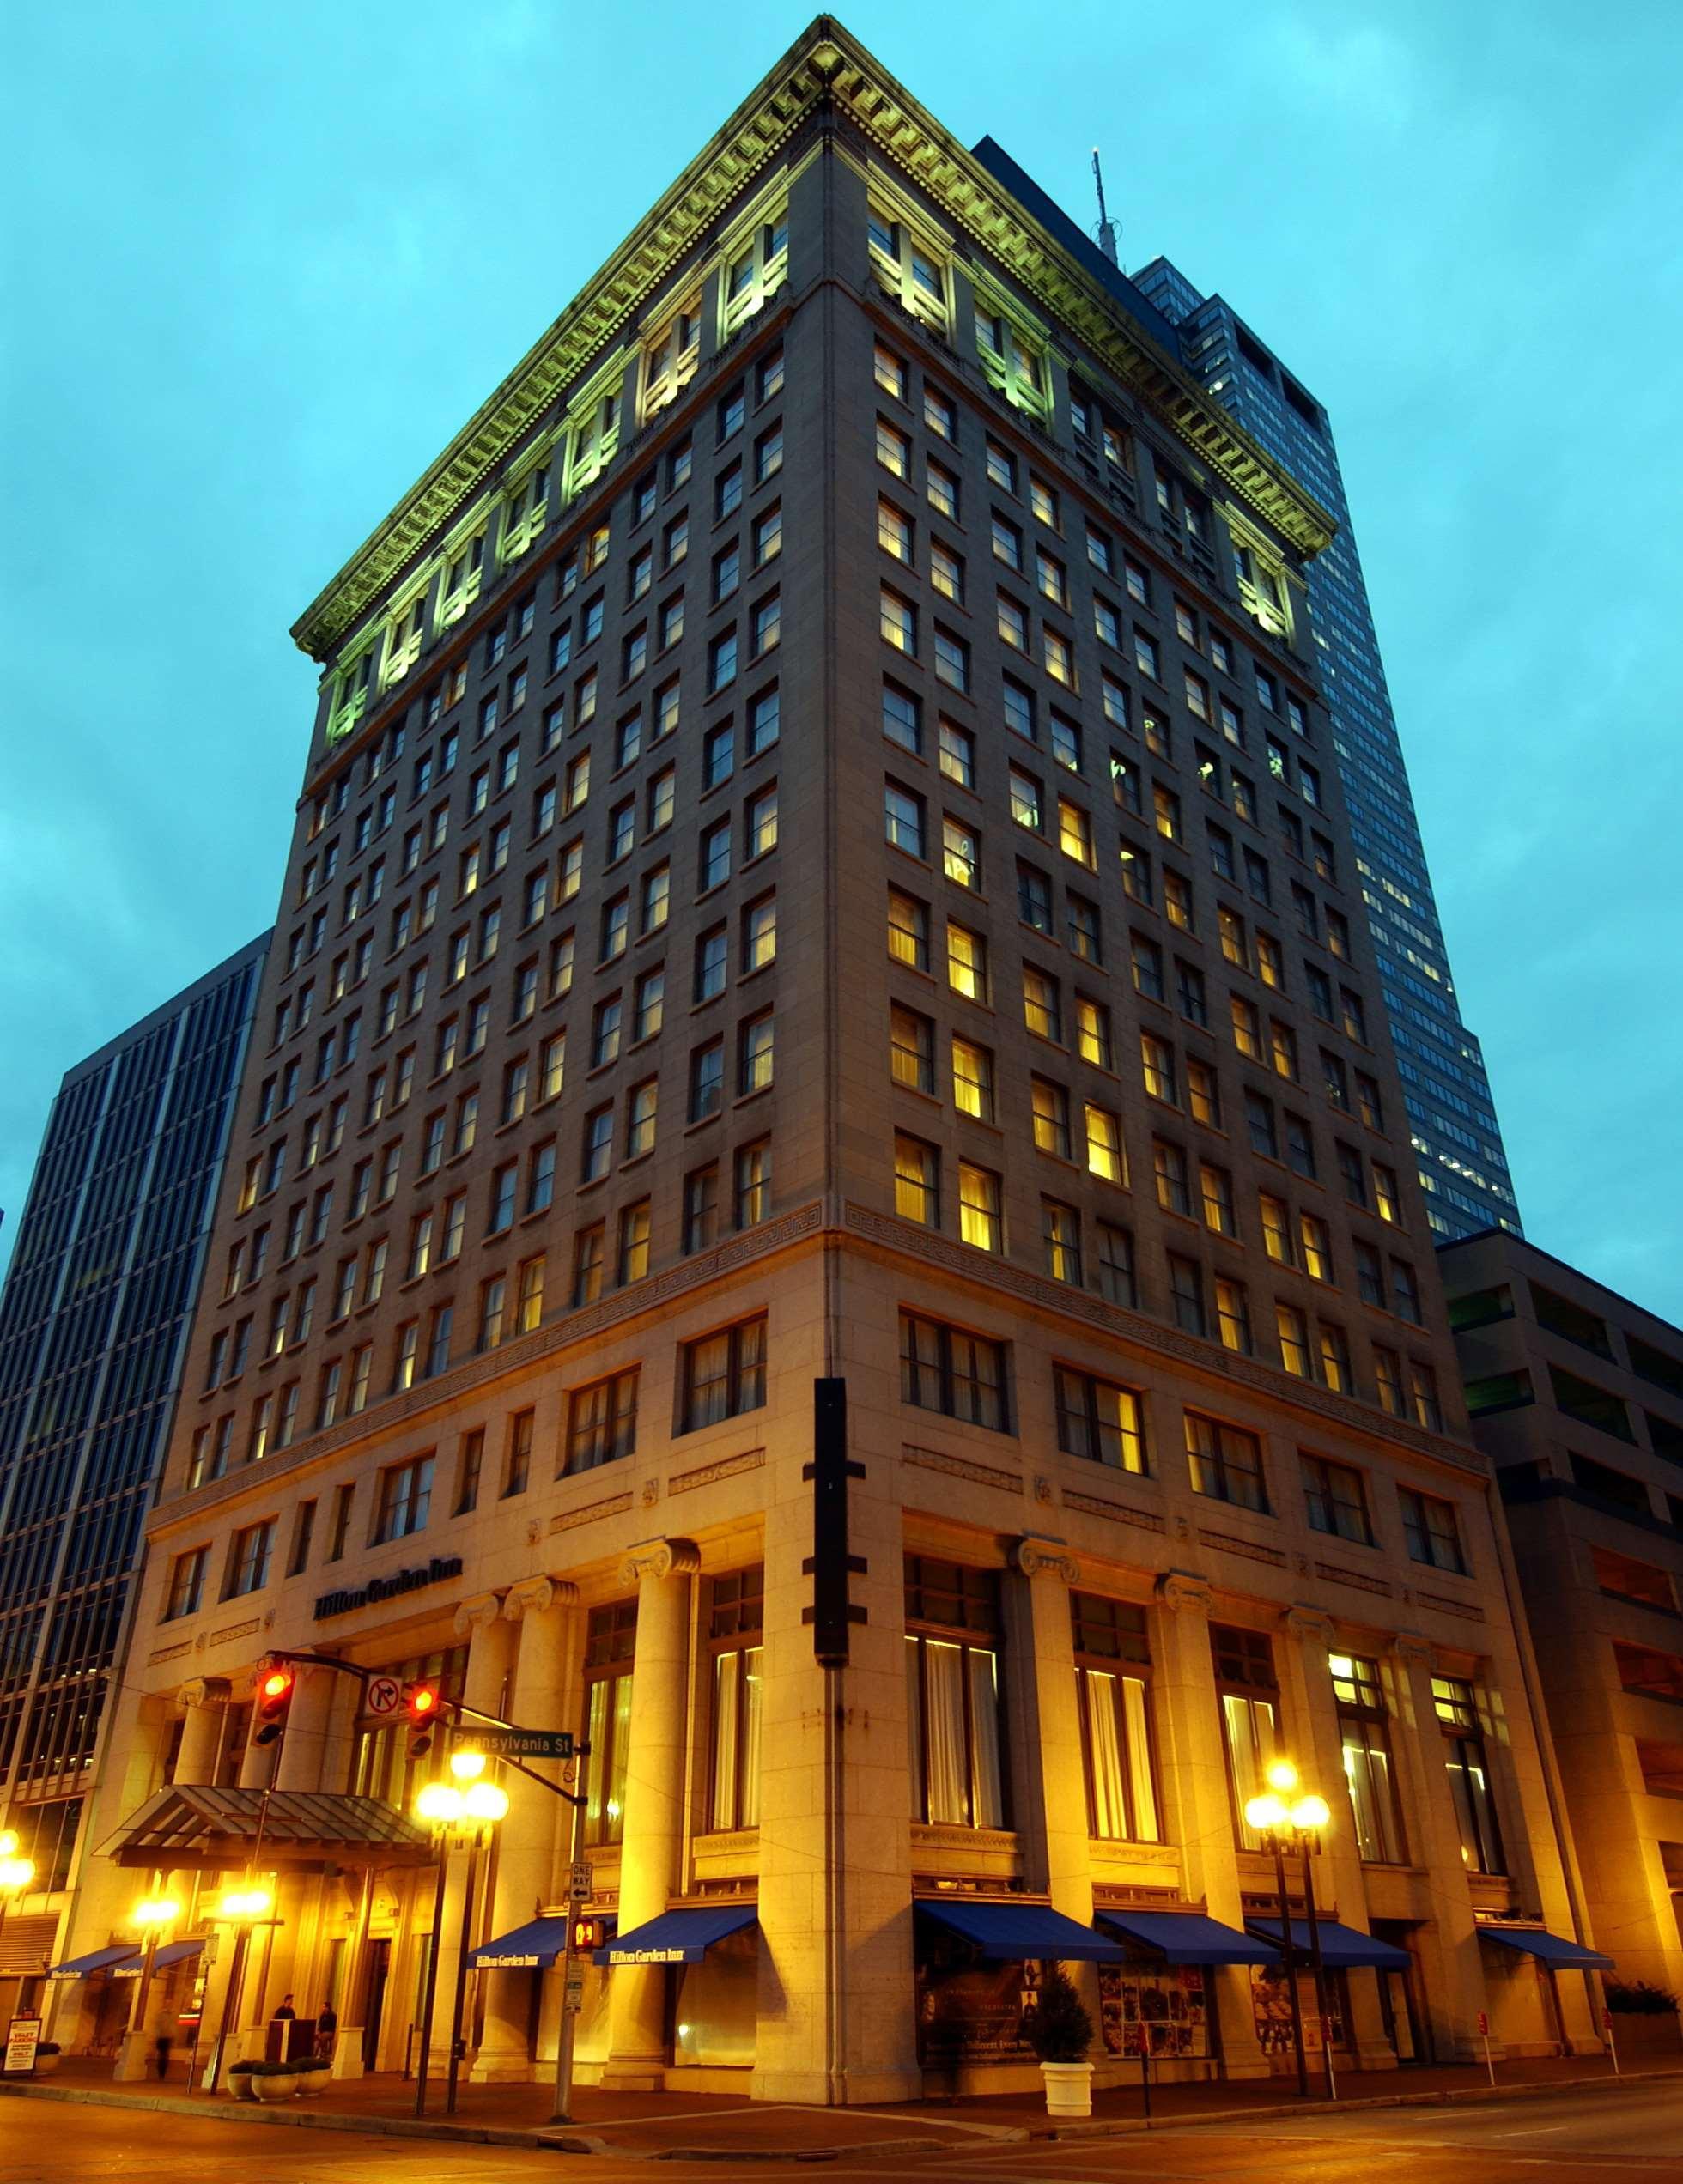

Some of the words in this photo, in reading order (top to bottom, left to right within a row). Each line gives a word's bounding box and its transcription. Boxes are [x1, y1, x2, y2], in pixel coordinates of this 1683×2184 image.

[313, 1590, 367, 1621] Hilton
[367, 1569, 428, 1604] Garden
[429, 1557, 463, 1582] Inn
[453, 1732, 550, 1752] Pennsylvania
[555, 1738, 570, 1752] St
[574, 1865, 590, 1875] ONE
[476, 1956, 498, 1968] Hilton
[499, 1954, 525, 1967] Garden
[525, 1954, 539, 1966] Inn
[610, 1950, 635, 1963] Hilton
[635, 1949, 667, 1963] Garden
[667, 1948, 685, 1962] Inn
